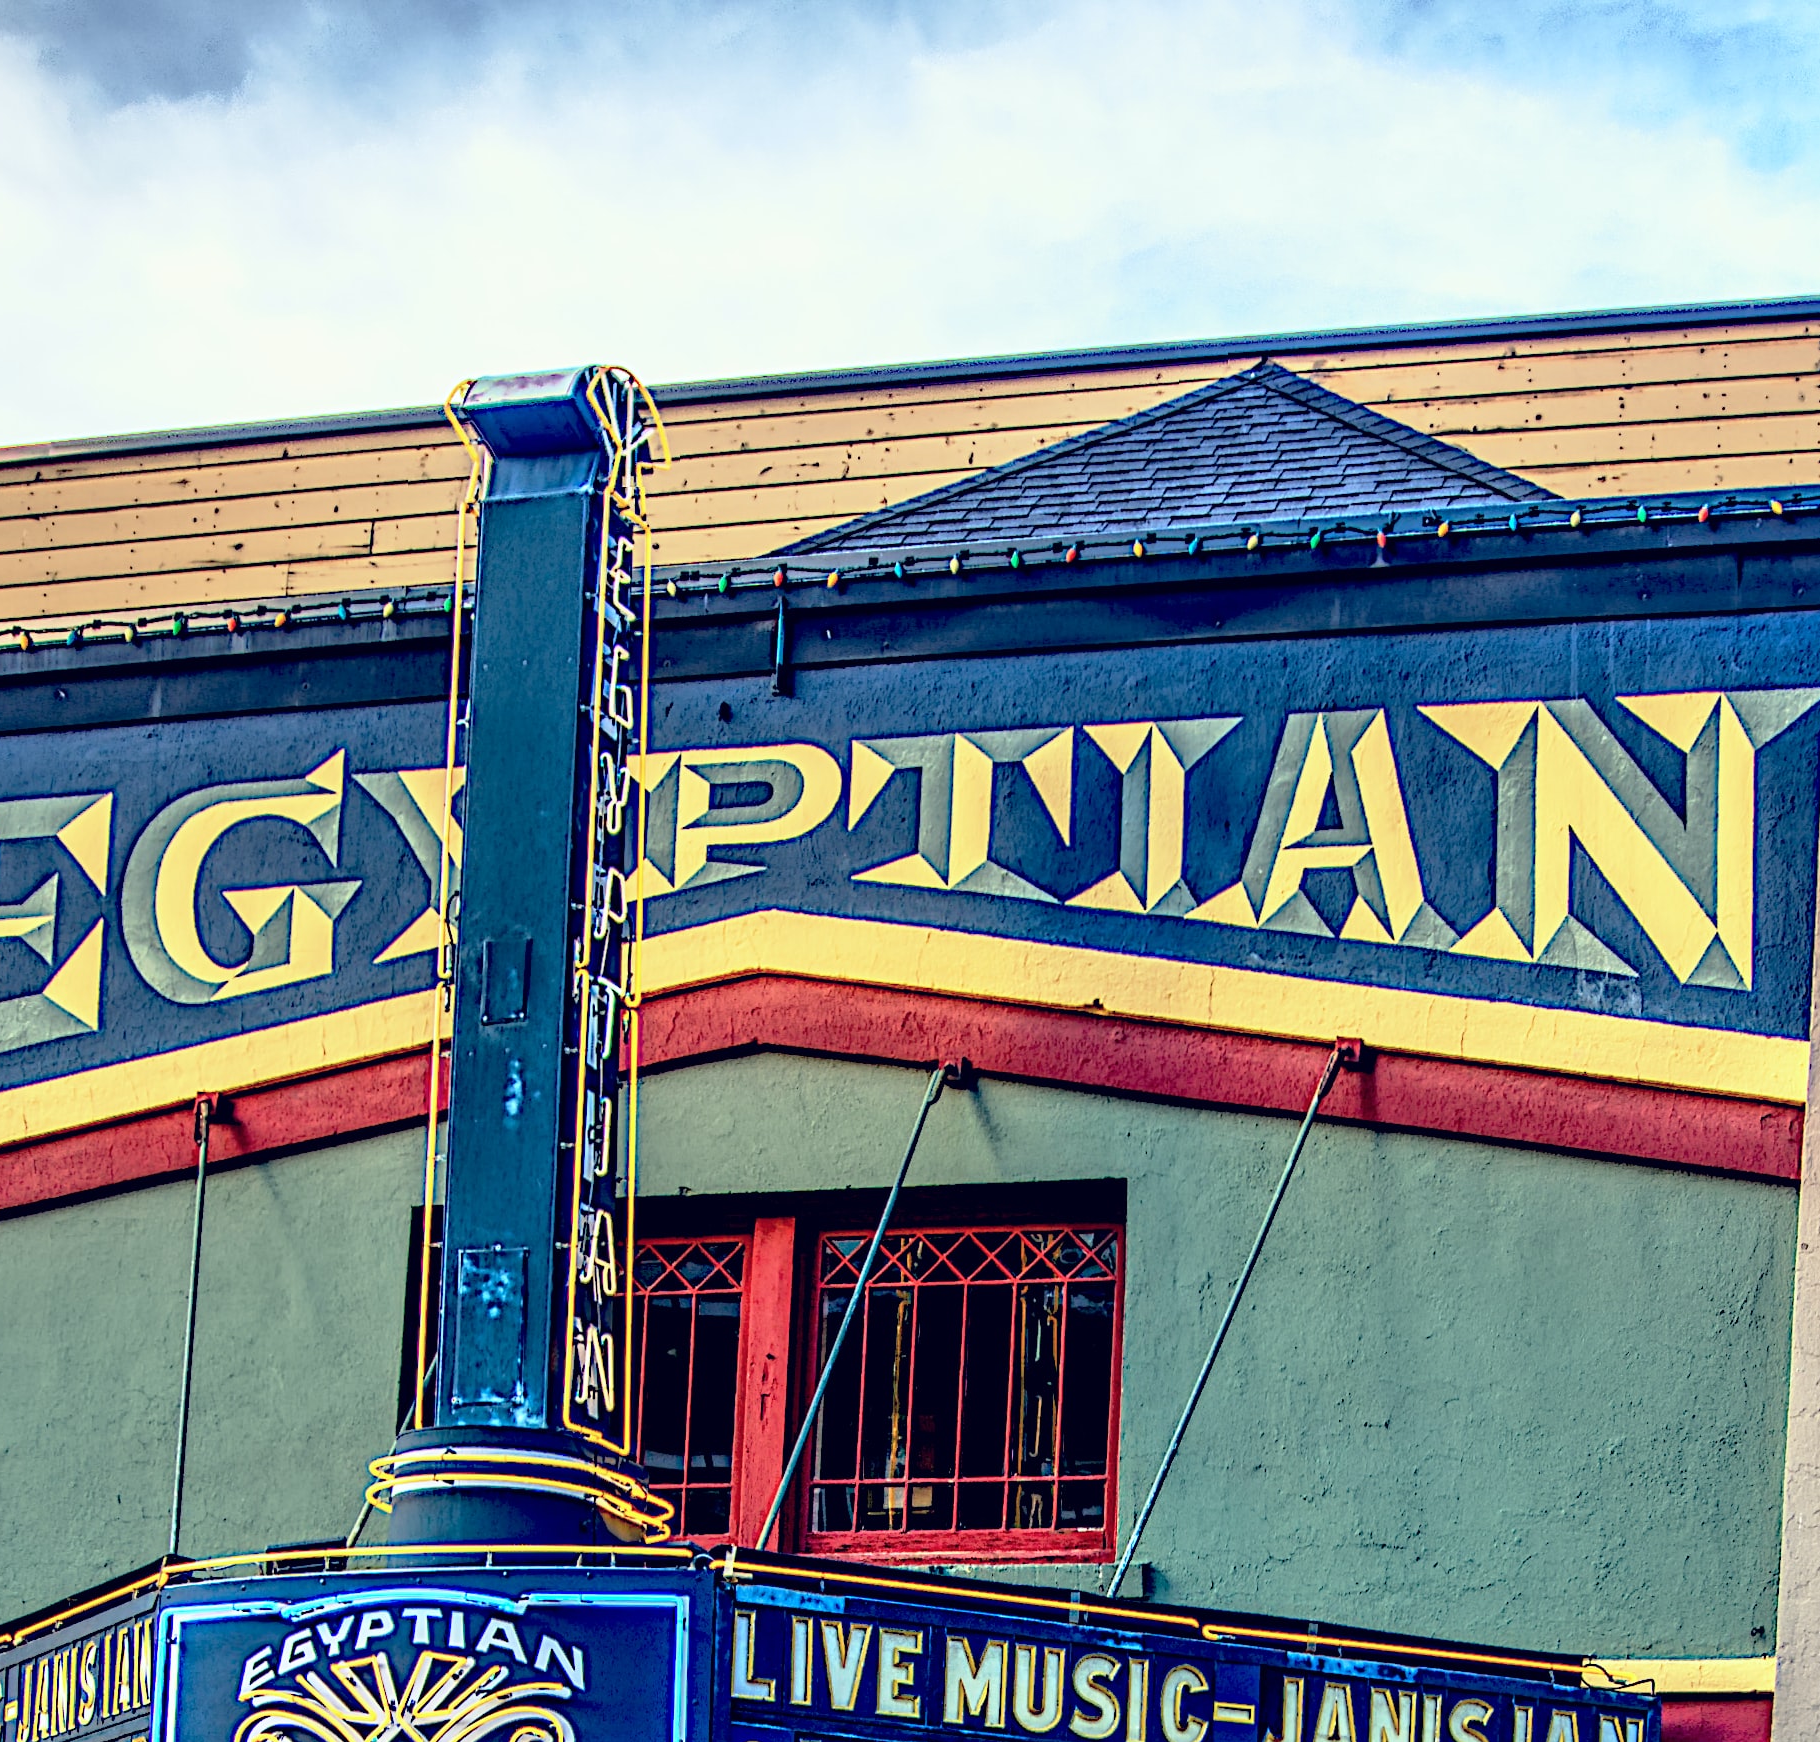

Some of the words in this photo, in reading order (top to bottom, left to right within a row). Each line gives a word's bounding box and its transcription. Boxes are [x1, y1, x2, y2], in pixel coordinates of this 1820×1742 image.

[101, 1618, 153, 1719] IAN
[240, 1607, 586, 1692] EGYPTIAN
[730, 1608, 923, 1719] LIVE
